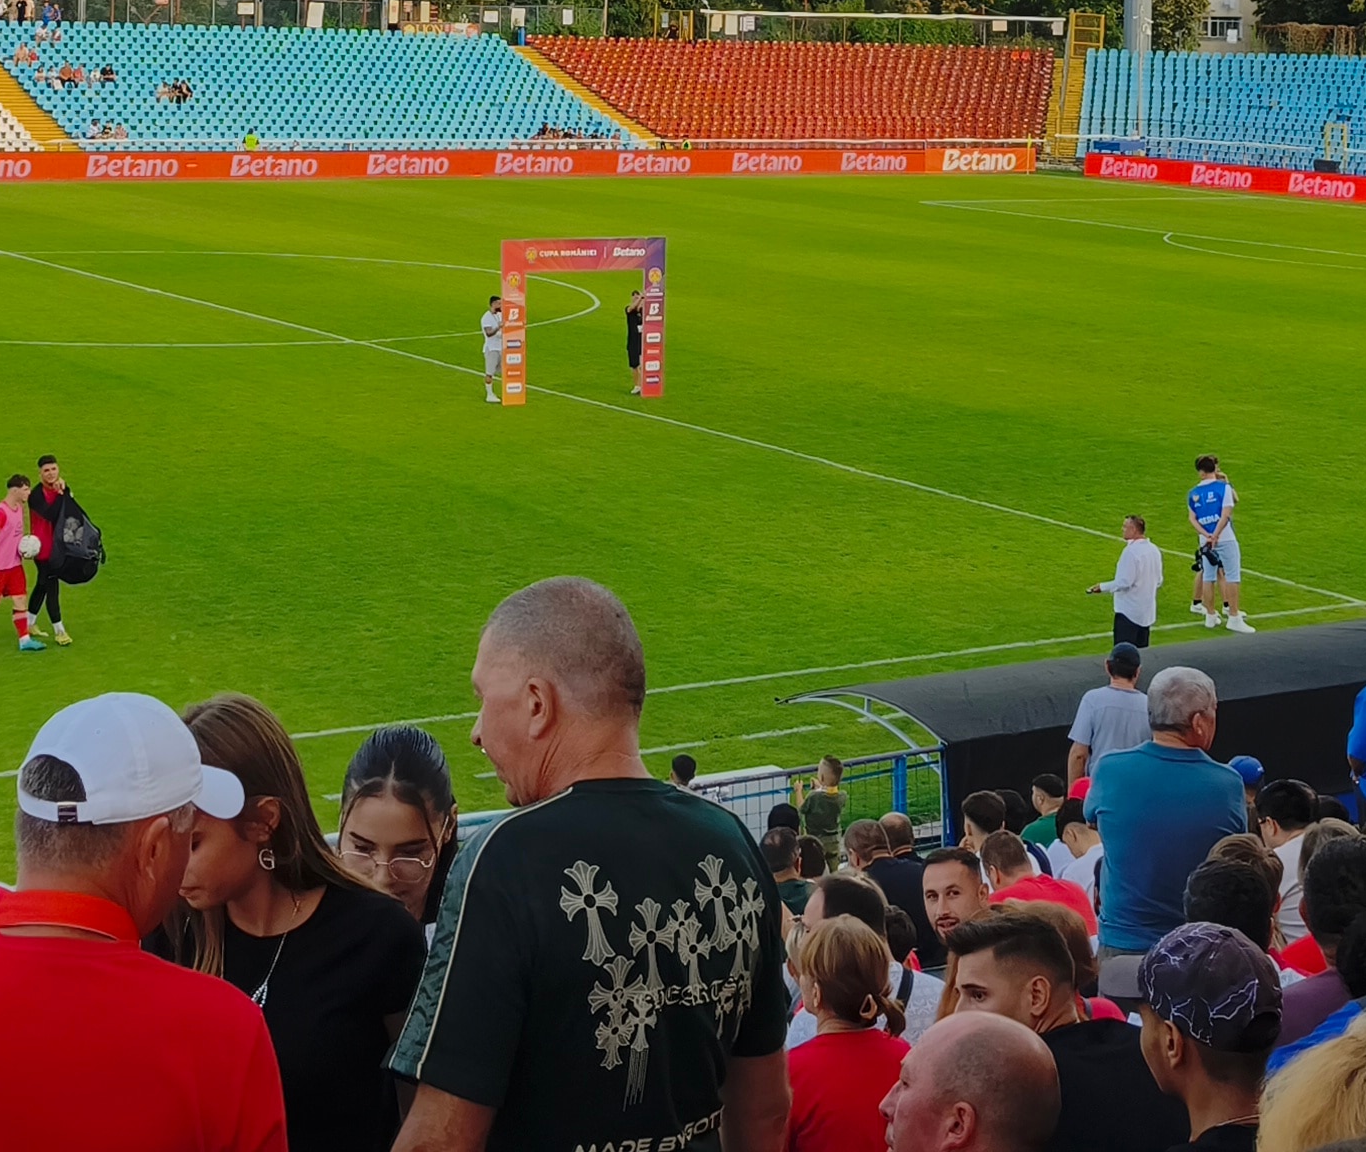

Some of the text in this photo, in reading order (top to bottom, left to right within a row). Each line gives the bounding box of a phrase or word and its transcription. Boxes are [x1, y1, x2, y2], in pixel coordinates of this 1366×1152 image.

[86, 155, 178, 177] Betano
[230, 154, 318, 176] Betano
[367, 153, 449, 175] Betano
[494, 152, 573, 173] Betano
[616, 152, 691, 173] Betano
[731, 151, 802, 172] Betano
[841, 151, 907, 171] Betano
[942, 149, 1016, 172] Betano
[1100, 156, 1157, 179] Betano
[1190, 164, 1252, 188] Betano
[1288, 172, 1356, 198] Betano
[613, 247, 646, 257] Betano
